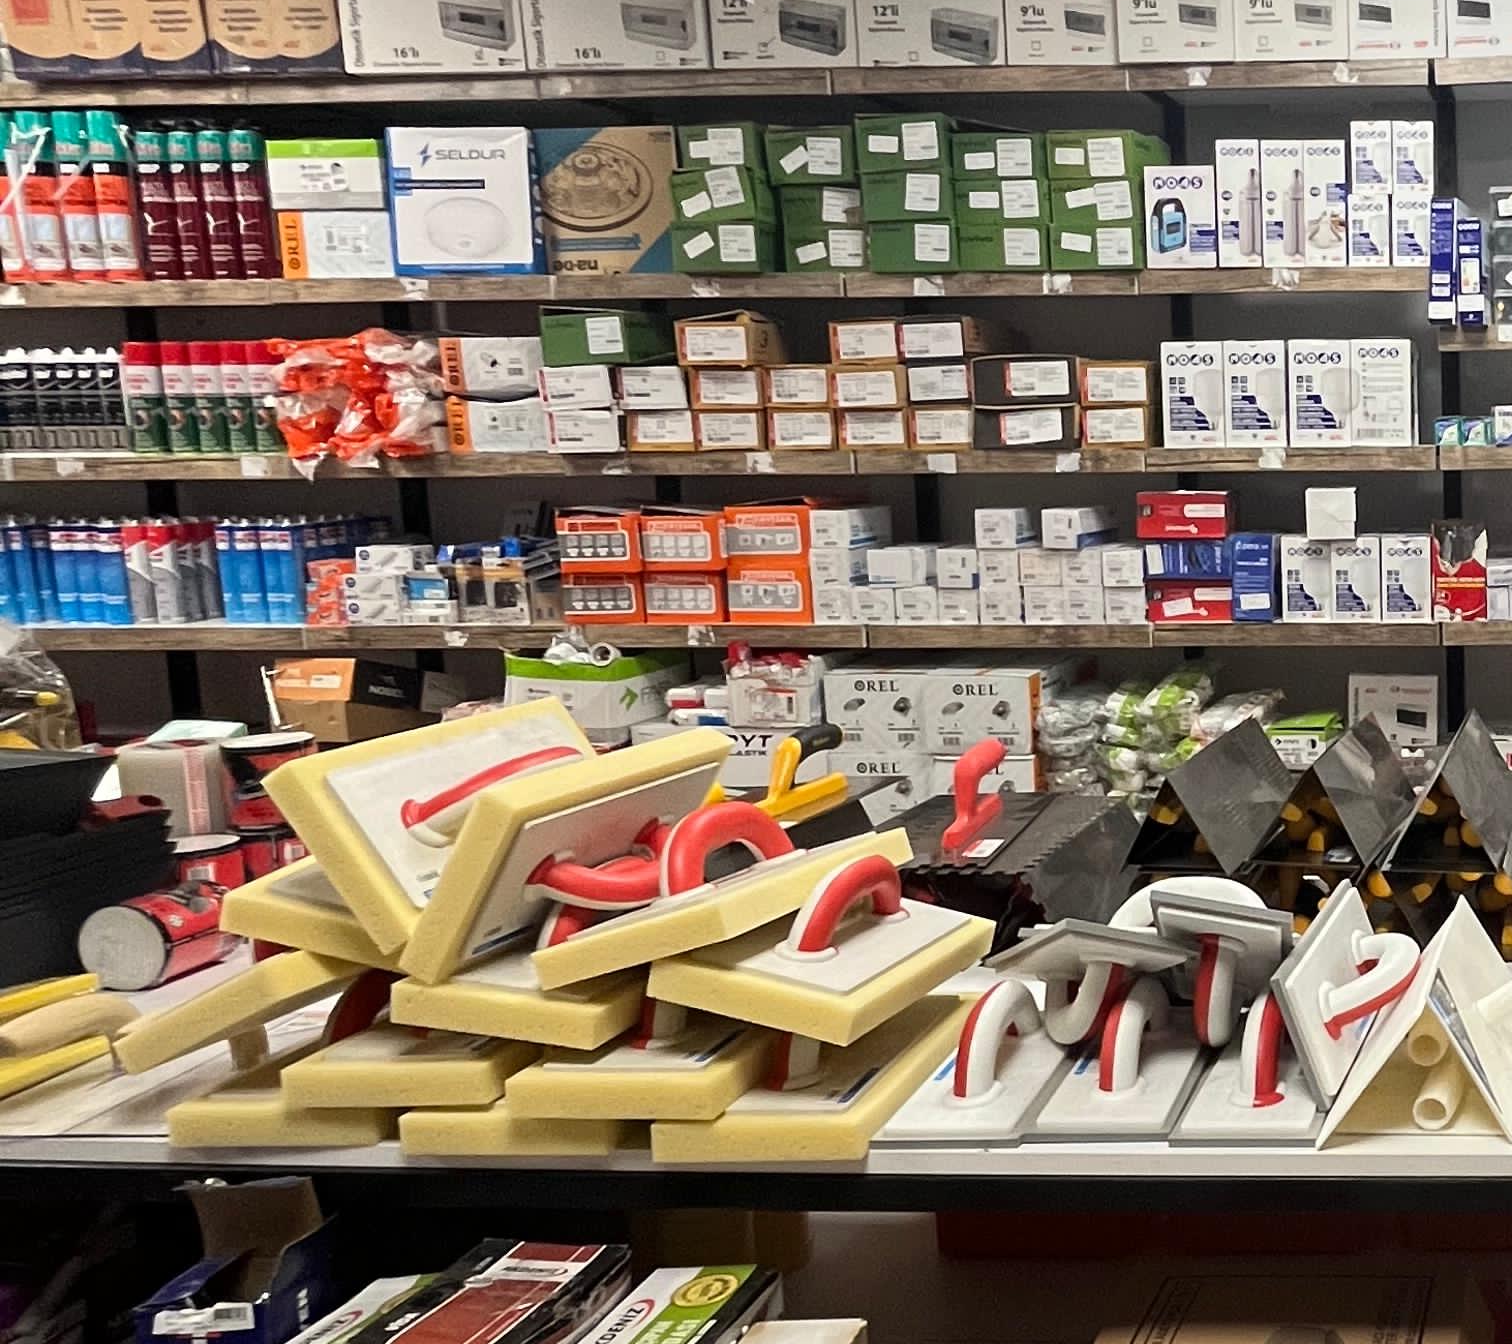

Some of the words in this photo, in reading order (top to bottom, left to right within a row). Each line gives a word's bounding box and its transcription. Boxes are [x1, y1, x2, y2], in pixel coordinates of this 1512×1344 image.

[872, 4, 899, 17] 12'li
[1019, 5, 1045, 17] 9'lu
[853, 679, 900, 693] OREL
[952, 683, 999, 696] OREL
[856, 761, 900, 775] OREL
